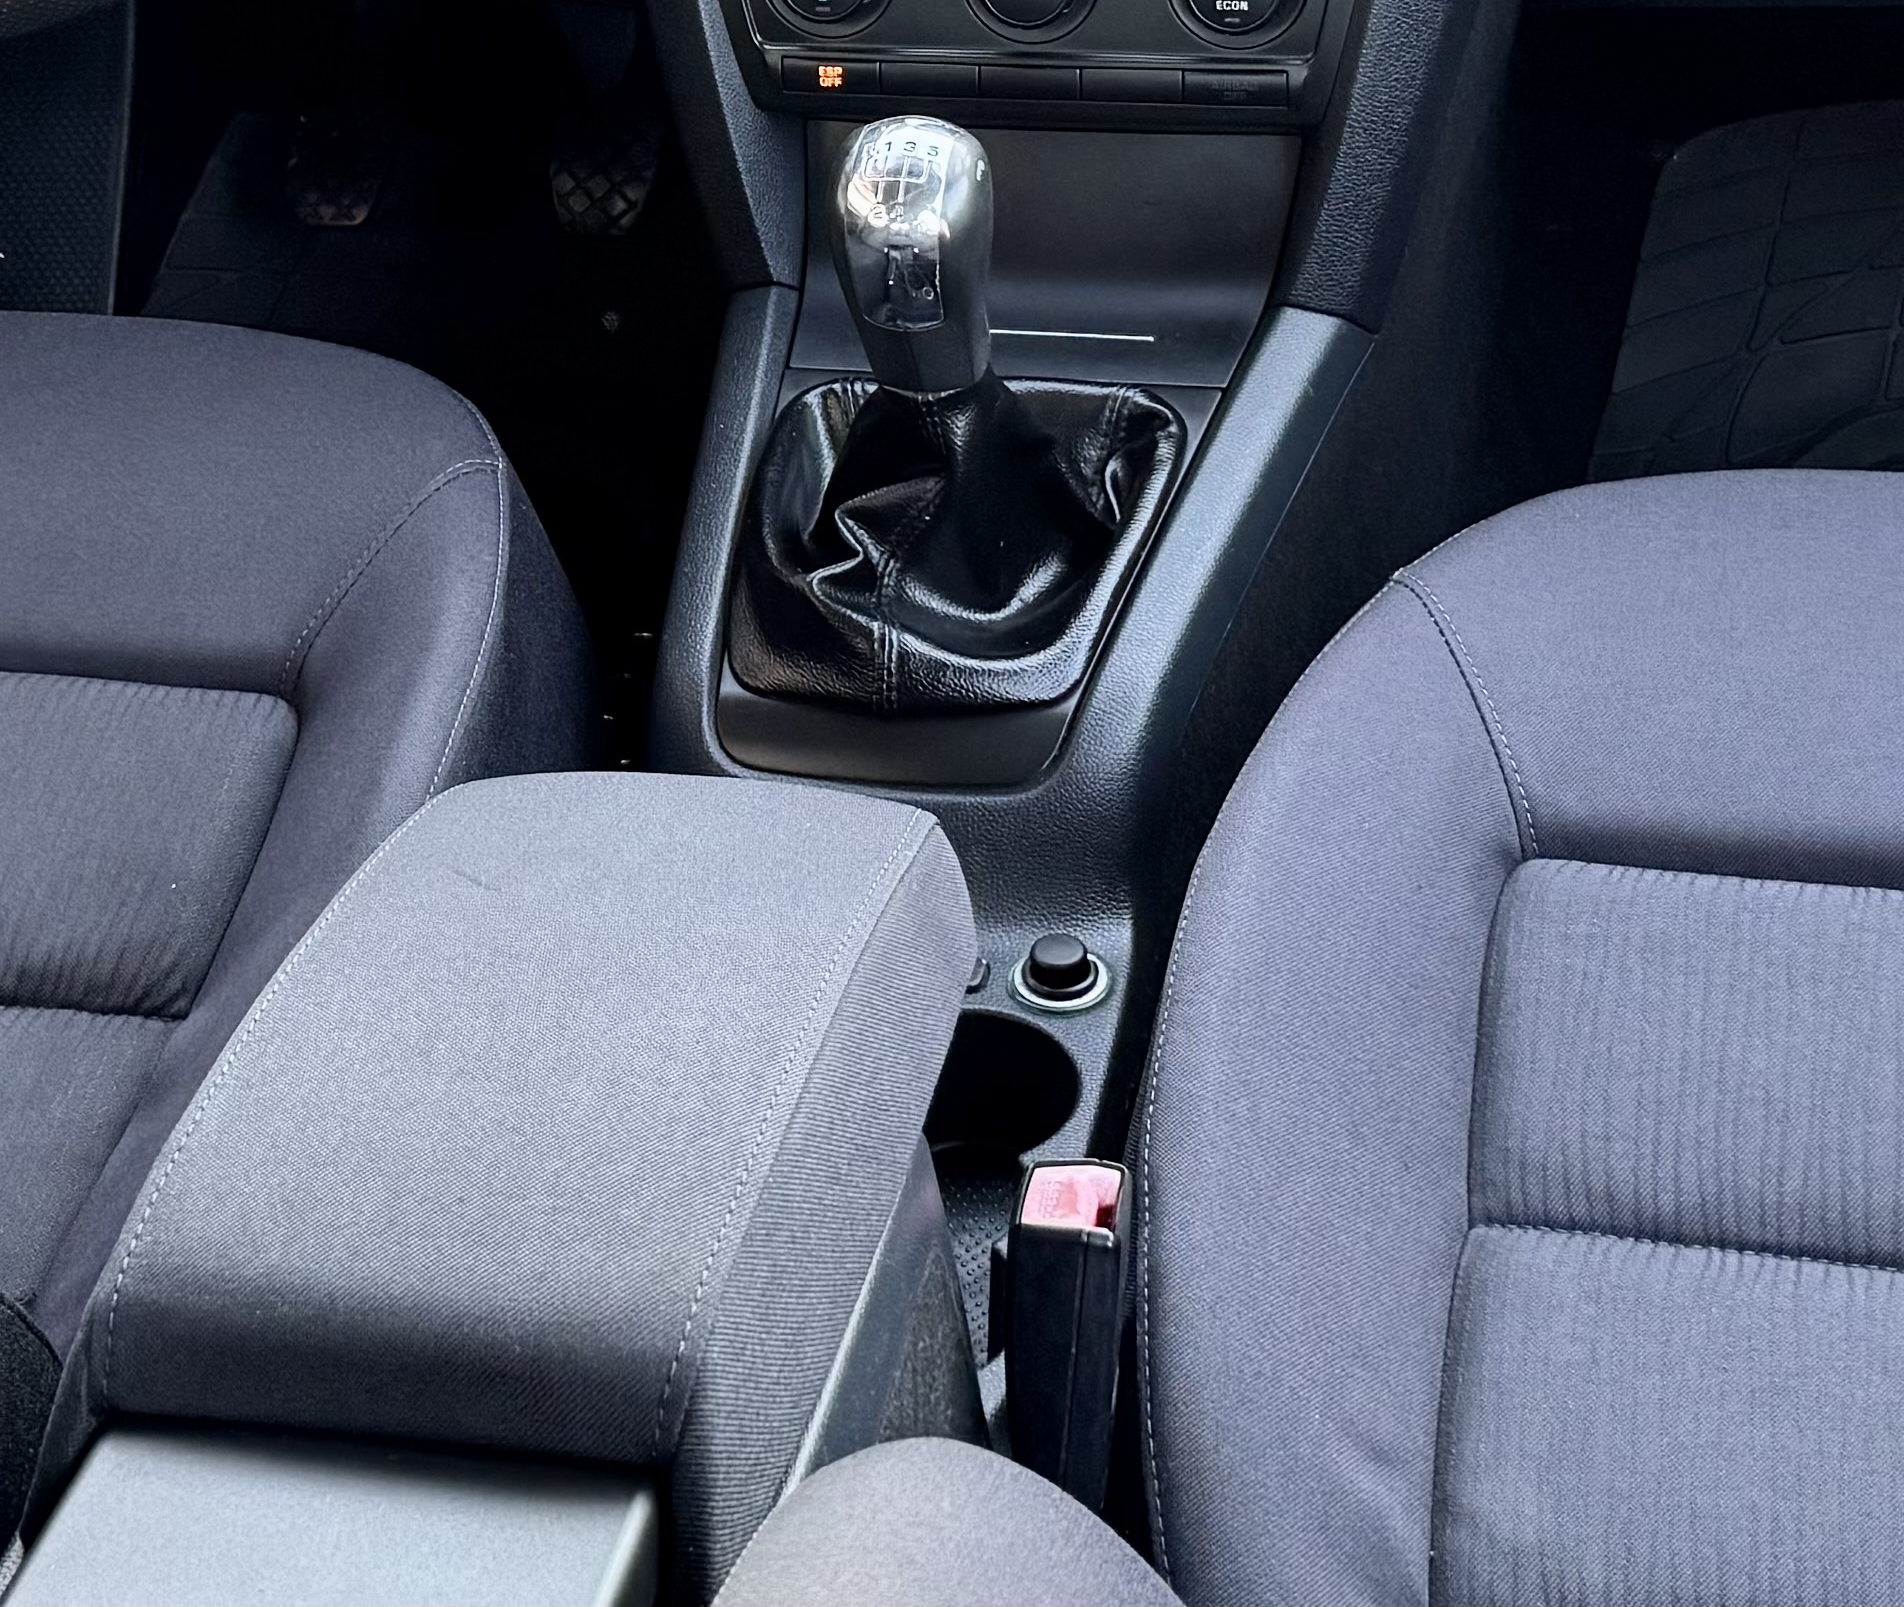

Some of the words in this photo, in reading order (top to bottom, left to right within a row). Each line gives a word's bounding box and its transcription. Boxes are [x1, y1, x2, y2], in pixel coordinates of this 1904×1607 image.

[1215, 0, 1249, 11] ECON
[818, 66, 843, 76] ESP
[819, 77, 842, 87] OFF
